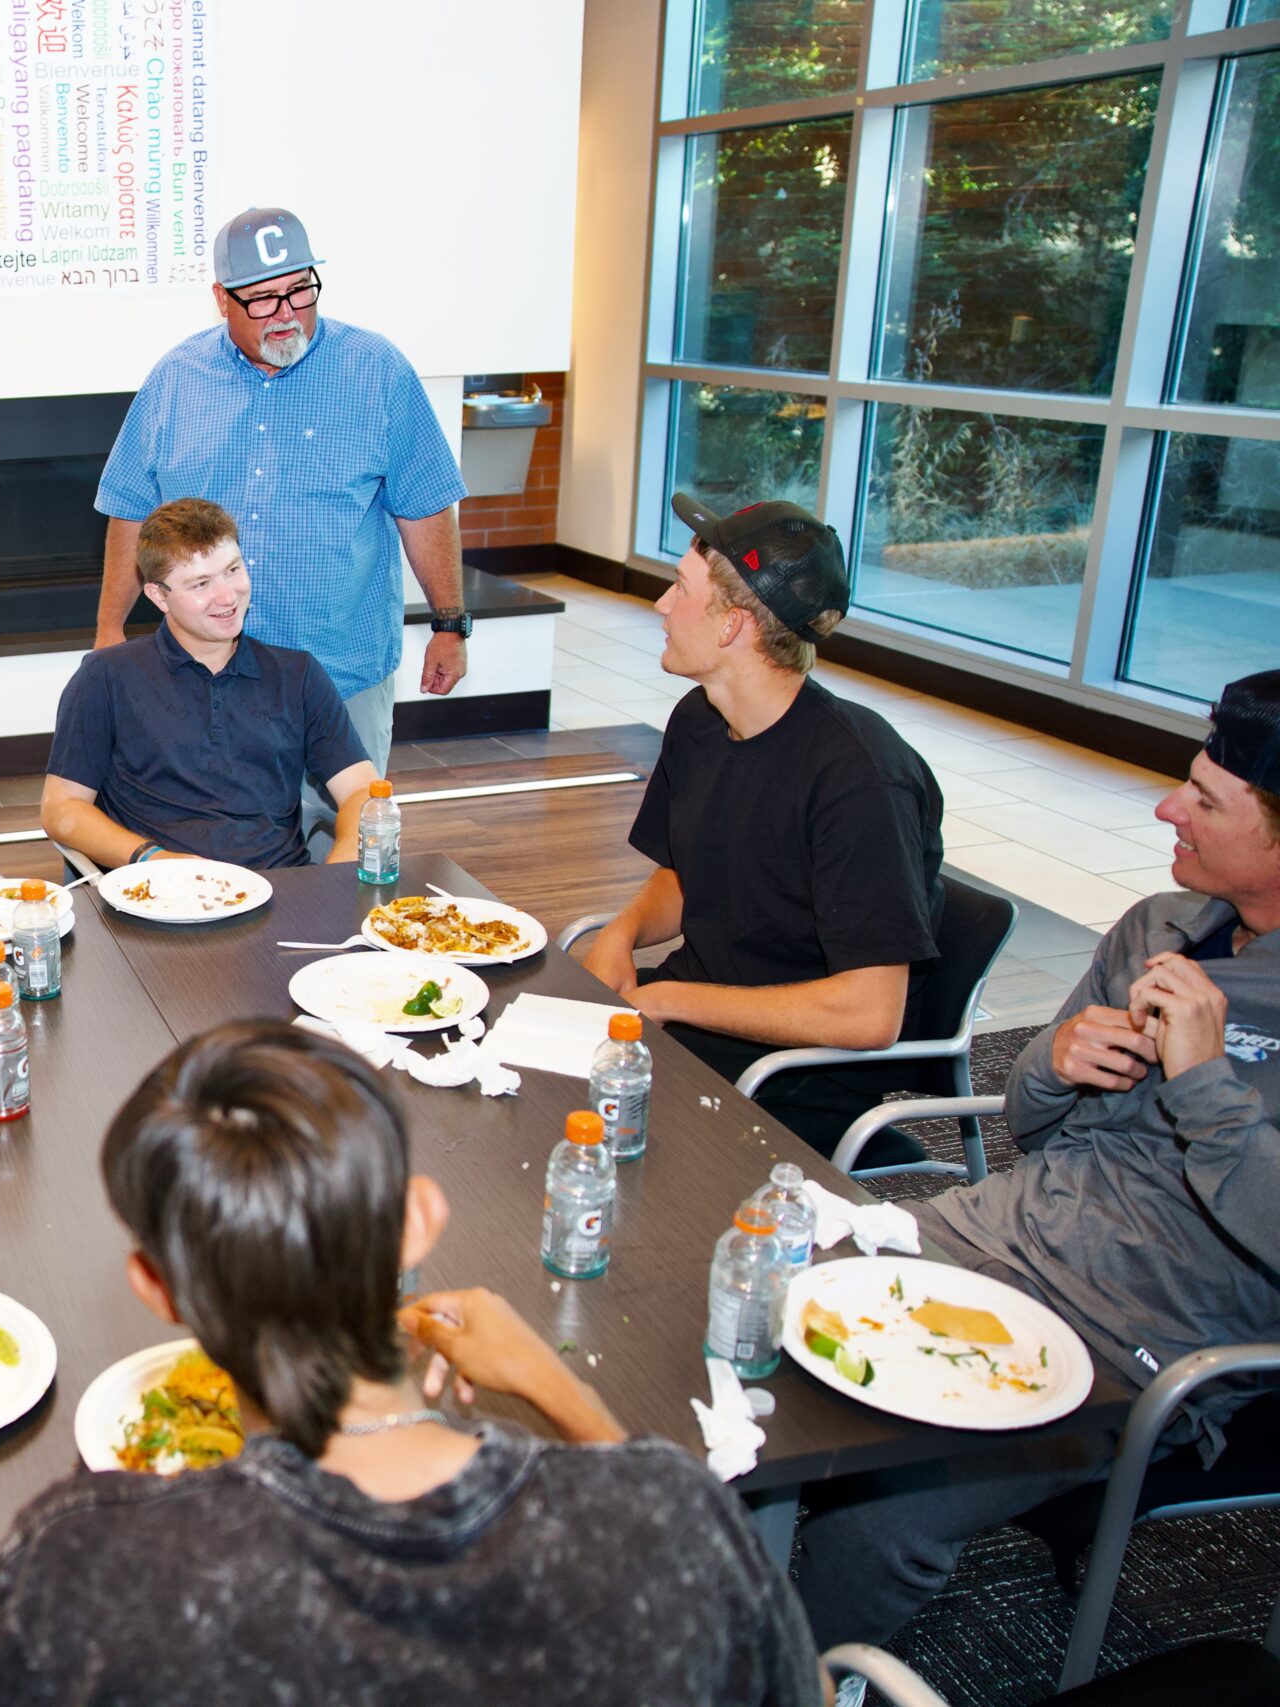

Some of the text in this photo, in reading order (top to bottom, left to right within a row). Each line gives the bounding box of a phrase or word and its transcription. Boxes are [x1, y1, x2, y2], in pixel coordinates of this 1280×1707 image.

[35, 61, 140, 80] Bienvenue
[172, 37, 184, 157] пожаловать
[56, 82, 72, 174] Benvenuto
[76, 83, 90, 174] Welcome
[96, 84, 108, 173] Tervetuloa
[189, 75, 208, 143] datang
[11, 124, 37, 243] pagdating
[40, 200, 111, 222] Witamy
[172, 162, 187, 257] Bun venit
[193, 150, 208, 257] Bienvenido
[41, 224, 111, 242] Welkom
[41, 243, 139, 267] Laipni lūdzam
[145, 198, 161, 285] Willkommen
[254, 224, 288, 267] C
[61, 267, 140, 289] ברוך הבא
[598, 1097, 620, 1121] G
[577, 1208, 602, 1237] G
